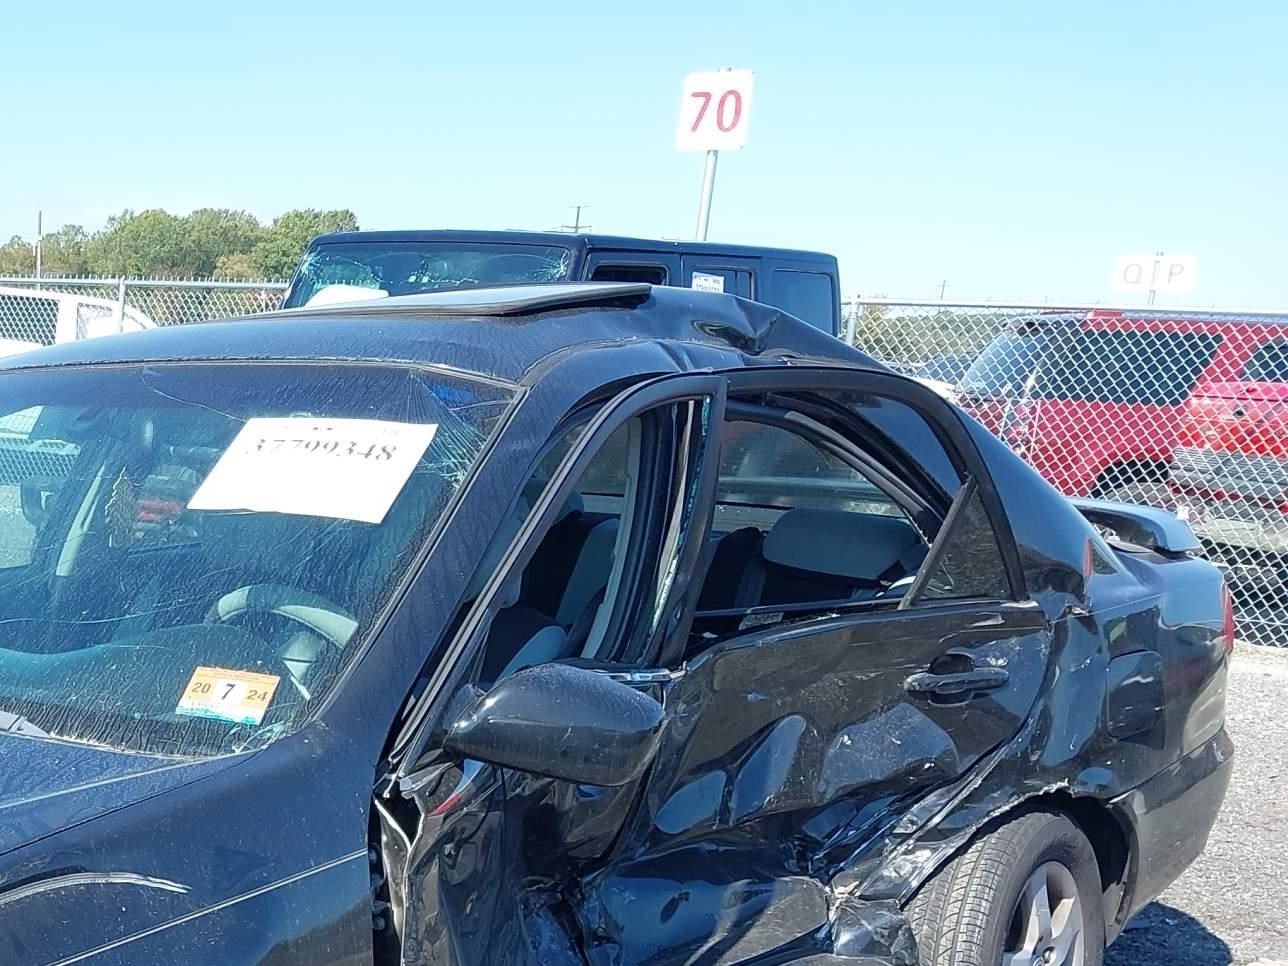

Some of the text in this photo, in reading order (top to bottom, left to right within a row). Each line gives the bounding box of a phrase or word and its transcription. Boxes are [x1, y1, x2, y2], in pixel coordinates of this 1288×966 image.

[691, 89, 742, 133] 70
[1123, 263, 1185, 285] Q P
[246, 438, 397, 462] 37799348
[192, 681, 268, 702] 20 7 24
